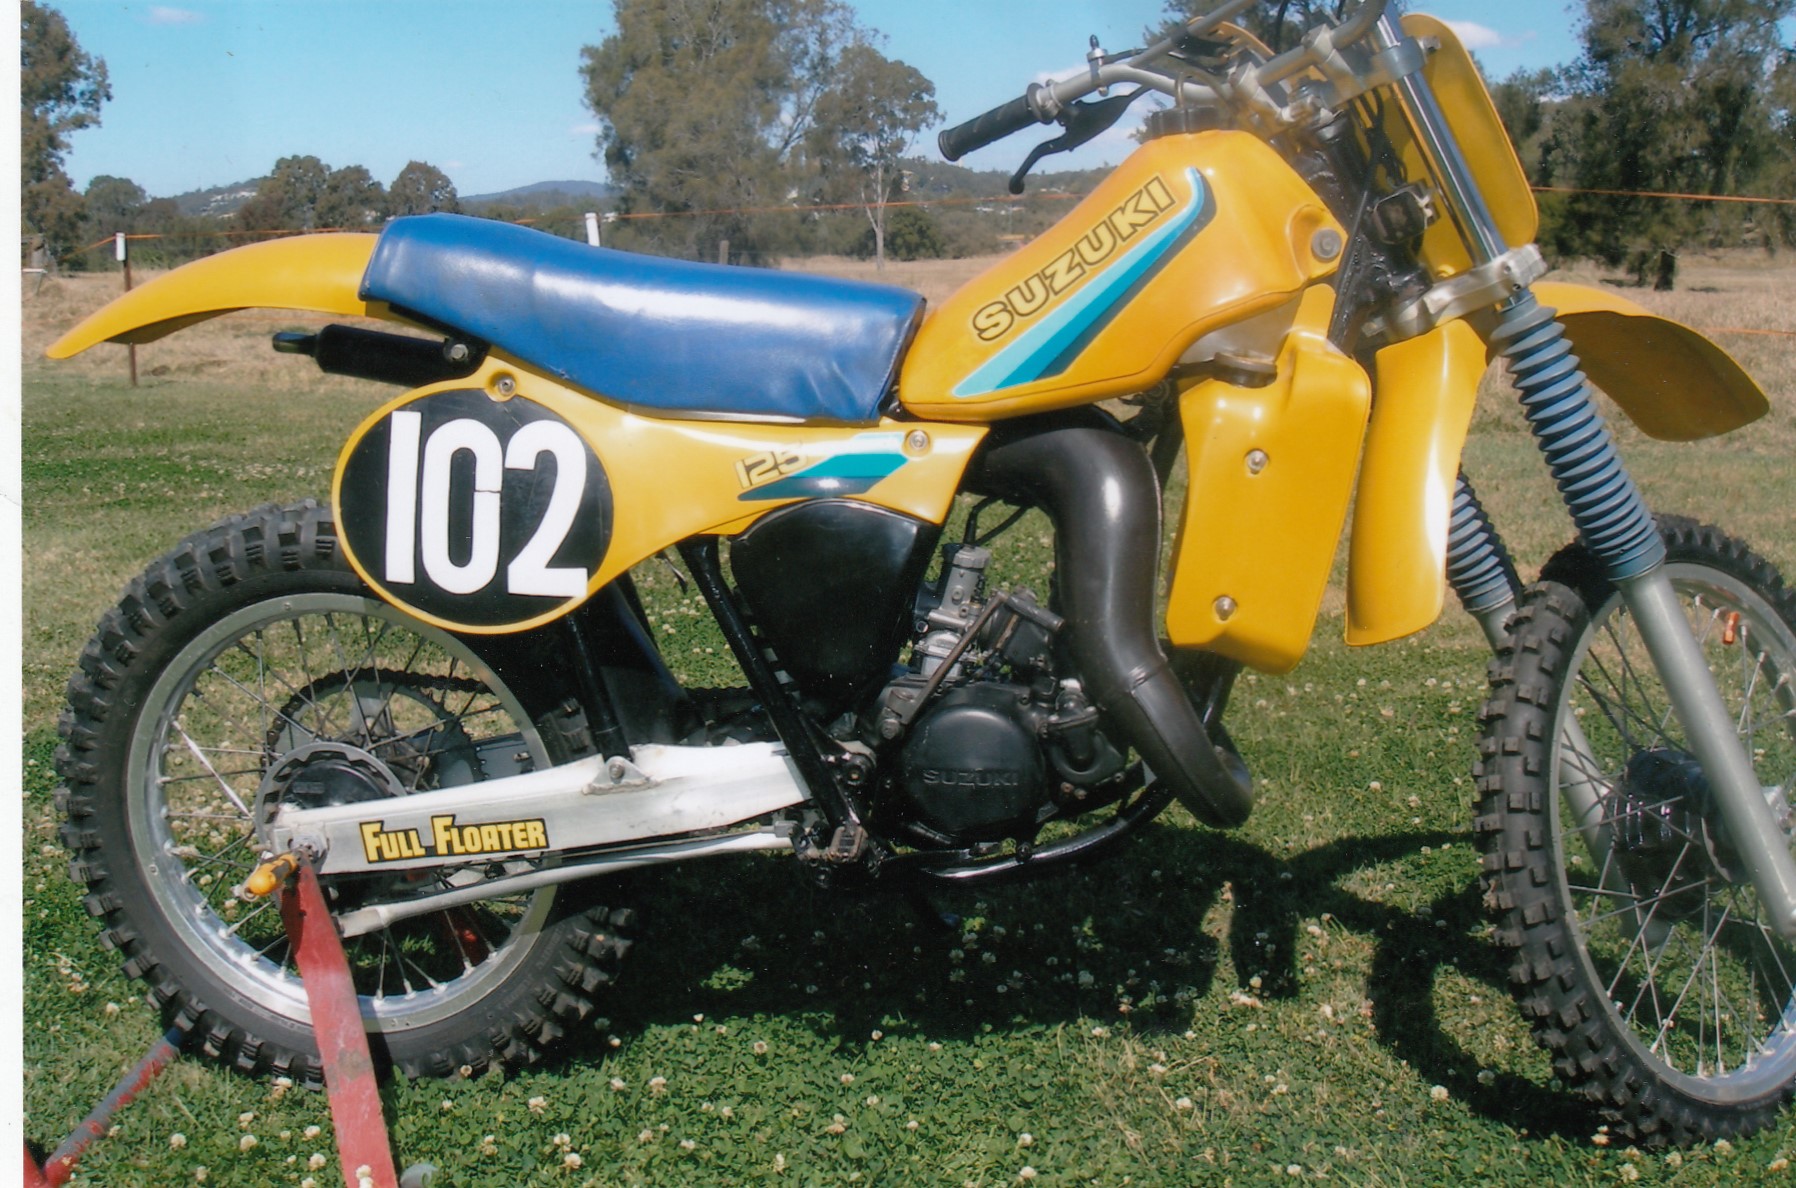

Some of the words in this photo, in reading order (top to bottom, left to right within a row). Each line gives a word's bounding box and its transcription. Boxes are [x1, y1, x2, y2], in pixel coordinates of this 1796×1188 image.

[972, 175, 1176, 341] SUZUKI
[734, 449, 807, 489] 125
[385, 410, 588, 598] 102
[922, 768, 1019, 787] SUZUKI
[360, 821, 427, 863] FULL
[431, 815, 549, 857] FLOATER
